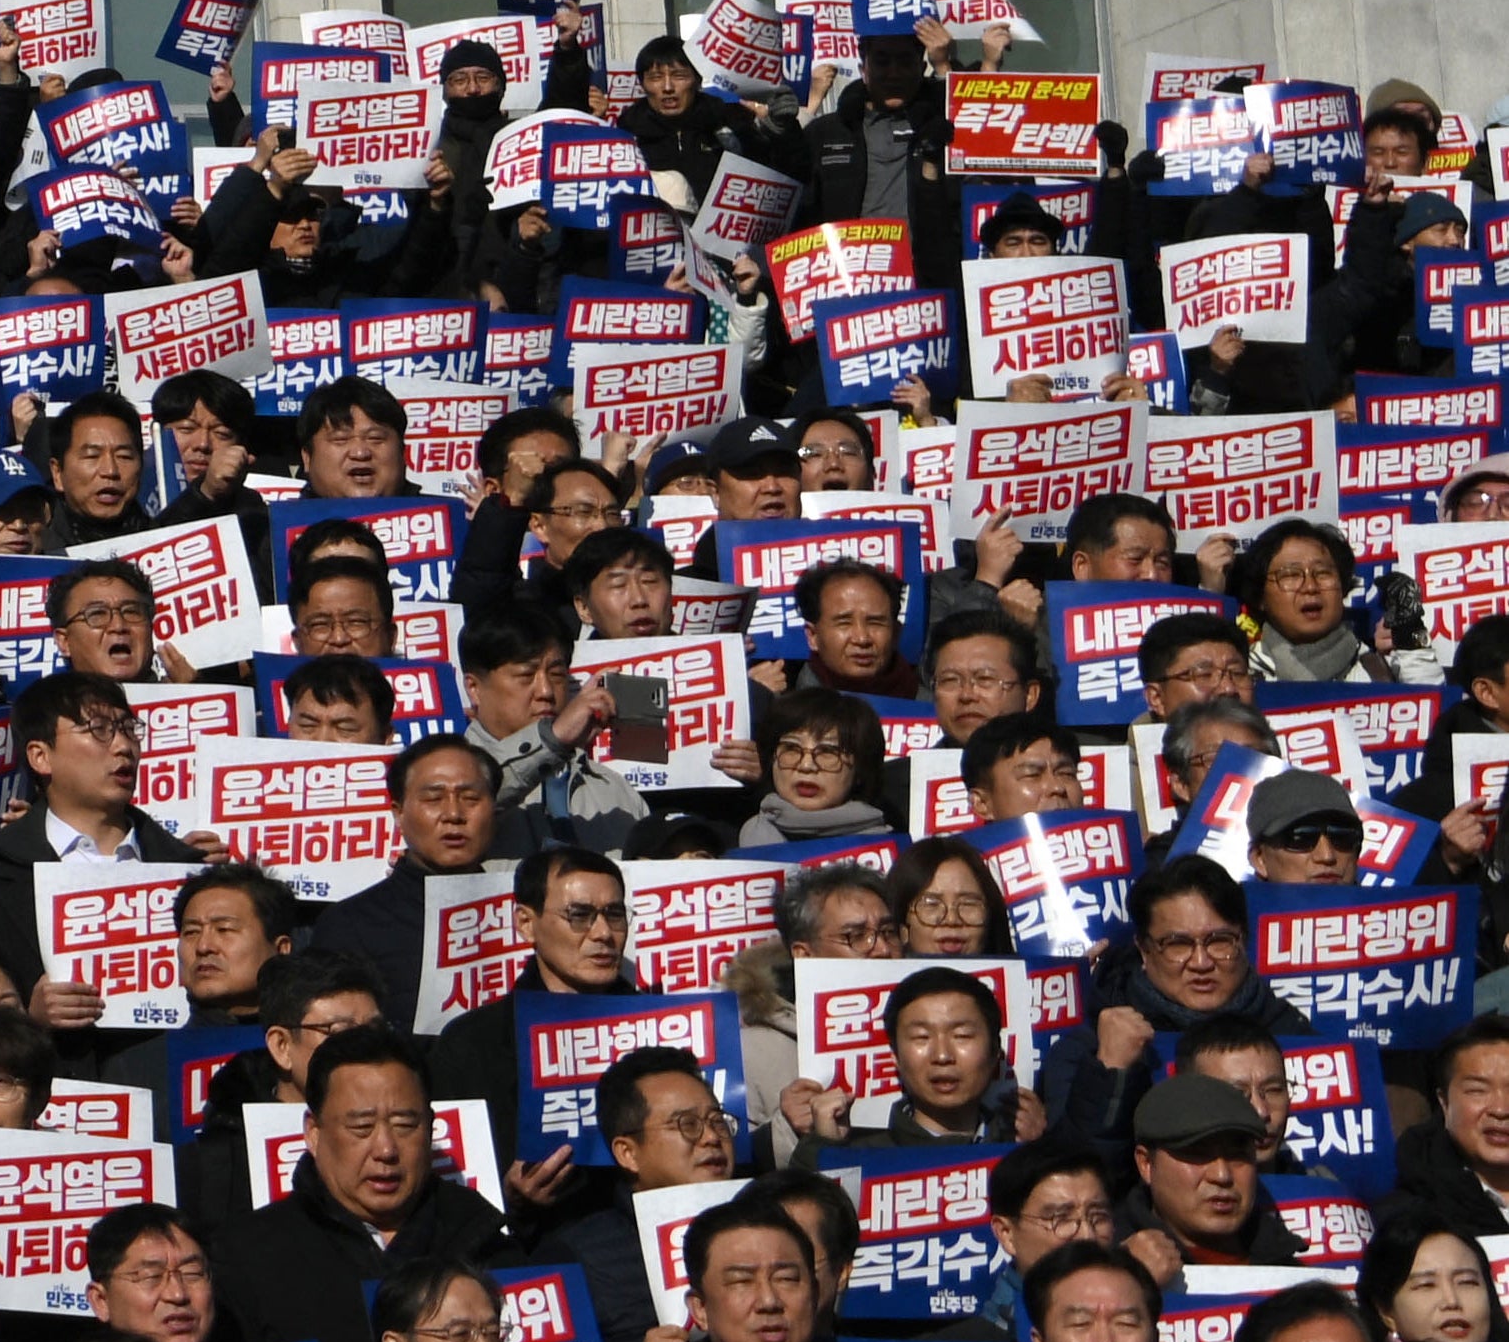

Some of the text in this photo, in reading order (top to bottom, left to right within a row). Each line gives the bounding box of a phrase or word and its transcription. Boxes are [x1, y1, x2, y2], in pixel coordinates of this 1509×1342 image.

[313, 93, 420, 133] 윤석열은
[953, 80, 1092, 100] 내란수괴 윤석열
[953, 102, 1026, 134] 즉각
[1011, 123, 1095, 154] 탄핵!
[308, 130, 431, 168] 사퇴하라!
[1175, 243, 1283, 298] 윤석열은
[124, 286, 239, 348] 윤석열은
[988, 271, 1114, 330] 윤석열은
[1180, 280, 1295, 329] 사퇴하라!
[134, 319, 255, 383] 사퇴하라!
[993, 319, 1122, 373] 사퇴하라!
[1267, 901, 1448, 965] 내란행위
[1269, 957, 1461, 1022] 즉각수사!
